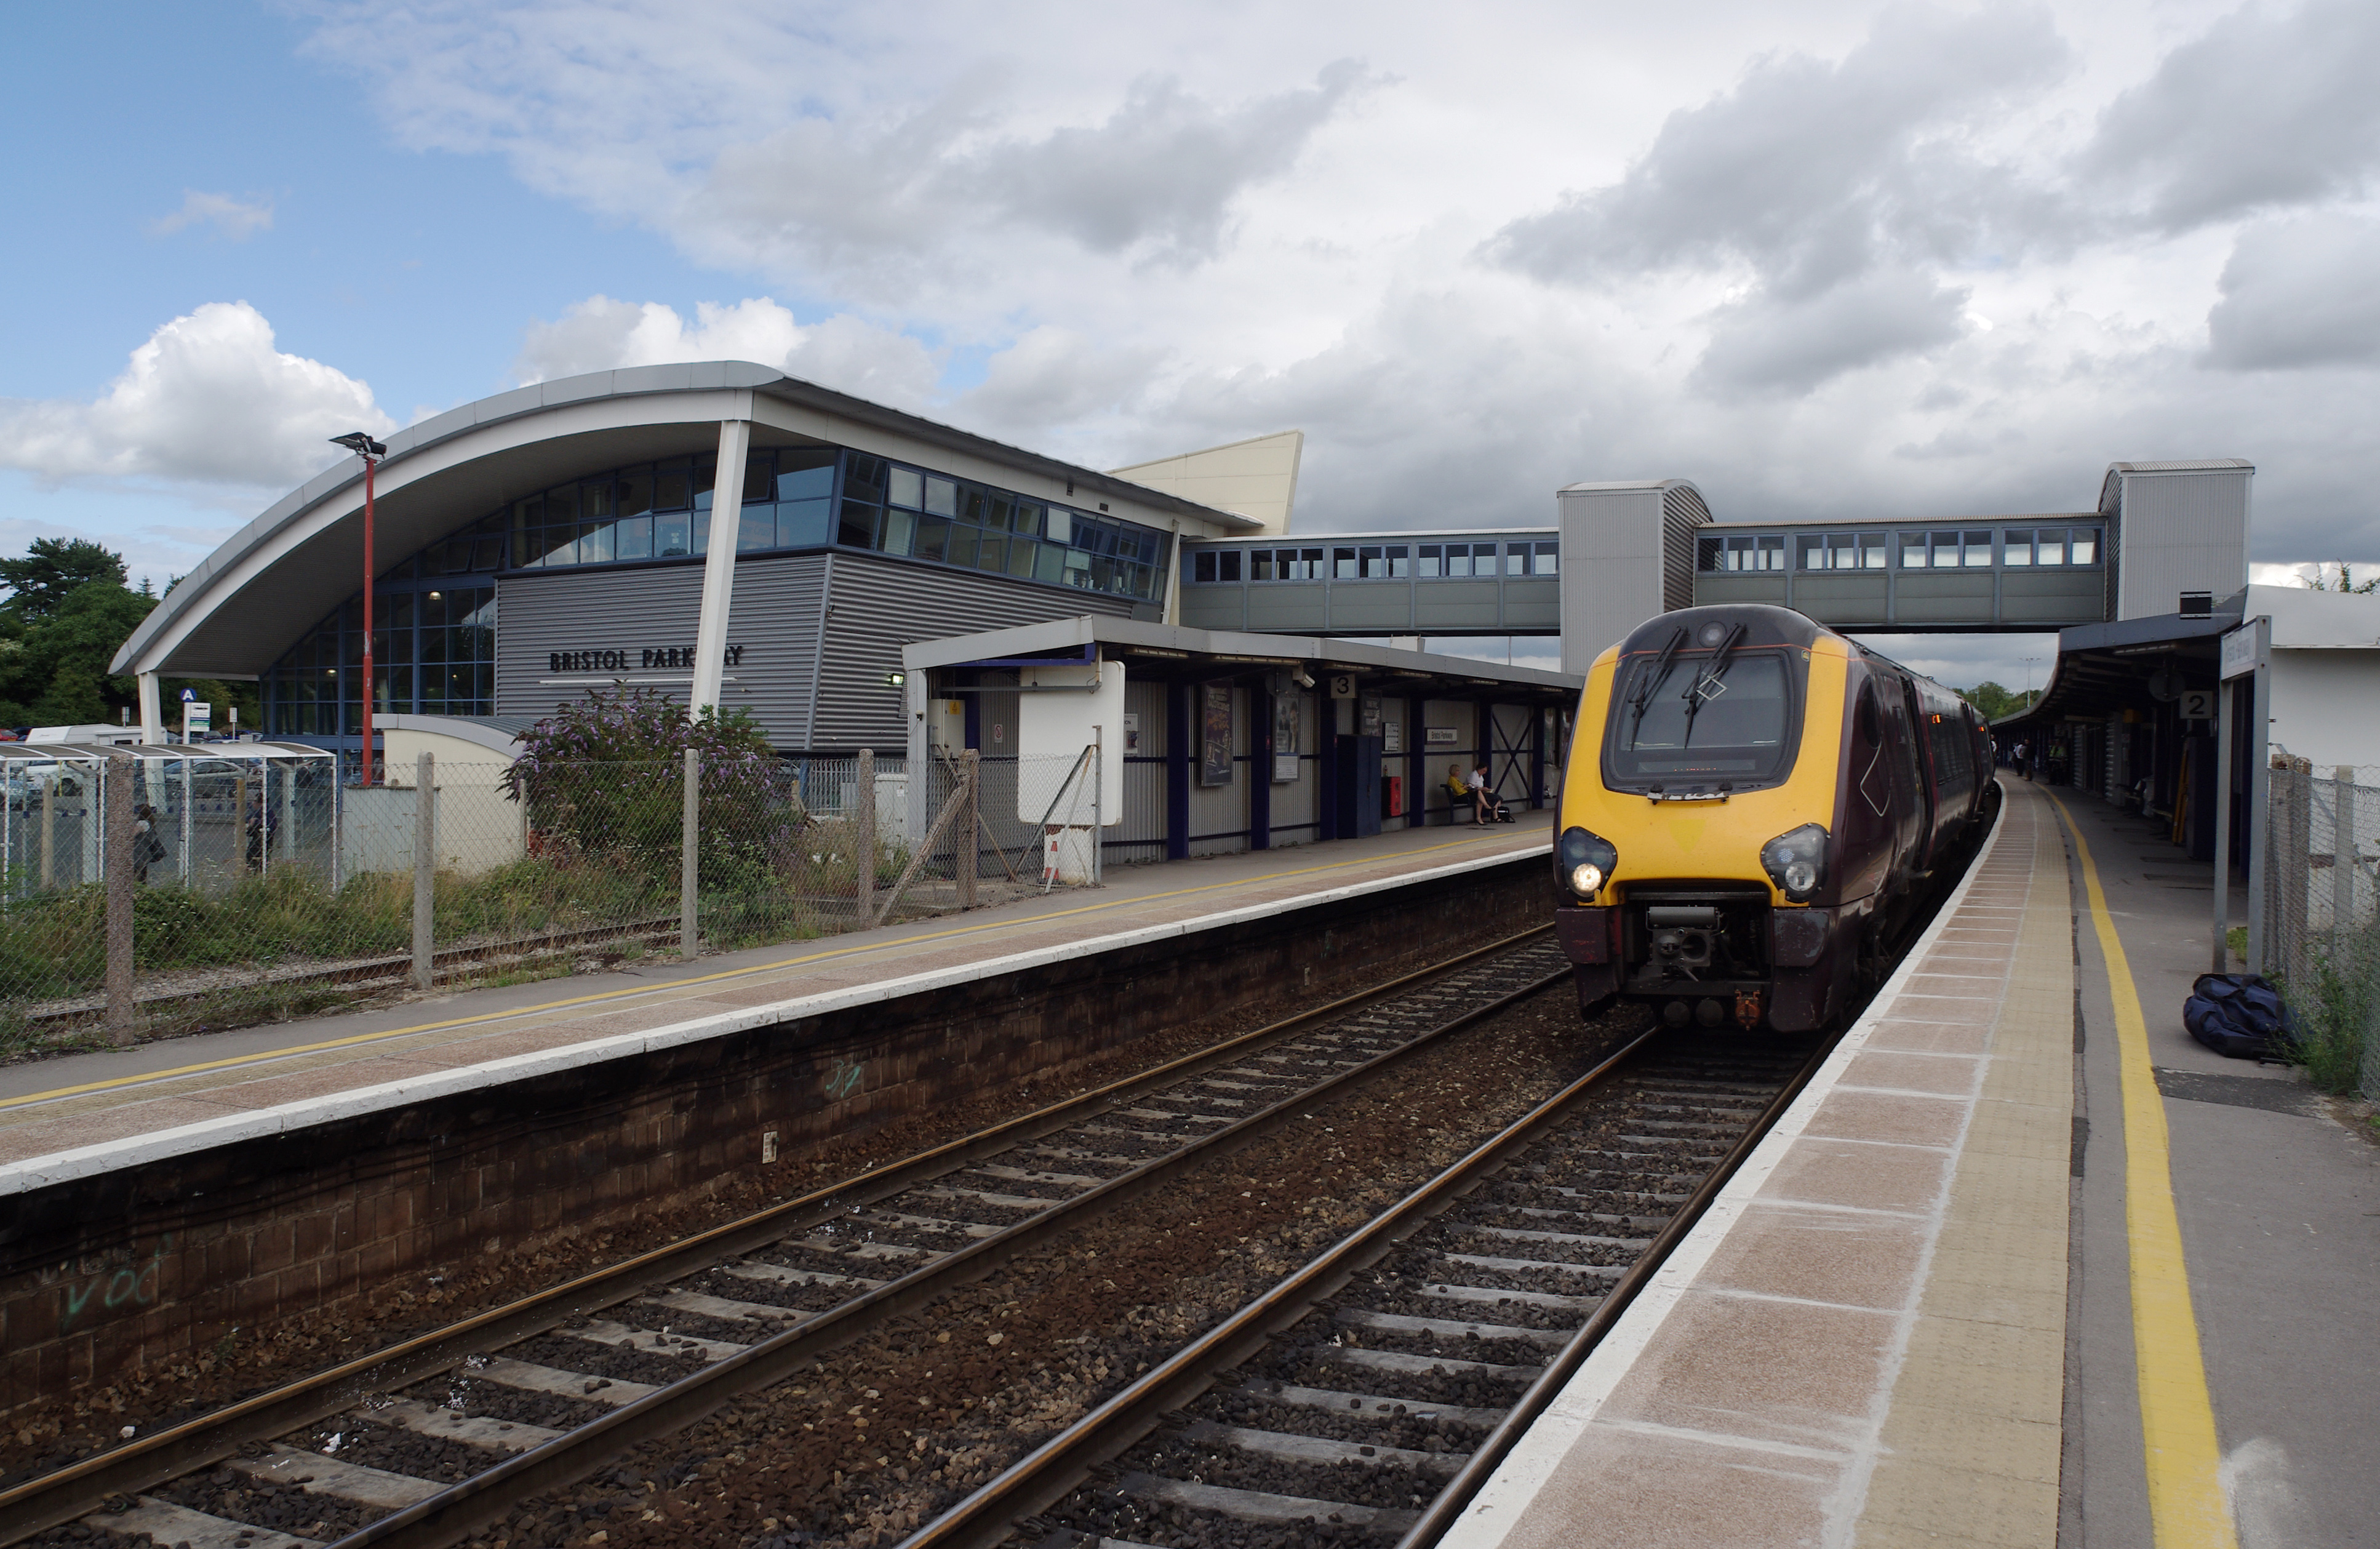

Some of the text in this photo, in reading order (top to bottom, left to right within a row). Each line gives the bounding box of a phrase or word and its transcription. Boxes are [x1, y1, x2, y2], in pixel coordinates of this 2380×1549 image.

[550, 646, 743, 671] BRISTOL PARKY
[182, 689, 194, 700] A
[1337, 677, 1349, 694] 3
[2189, 695, 2204, 714] 2
